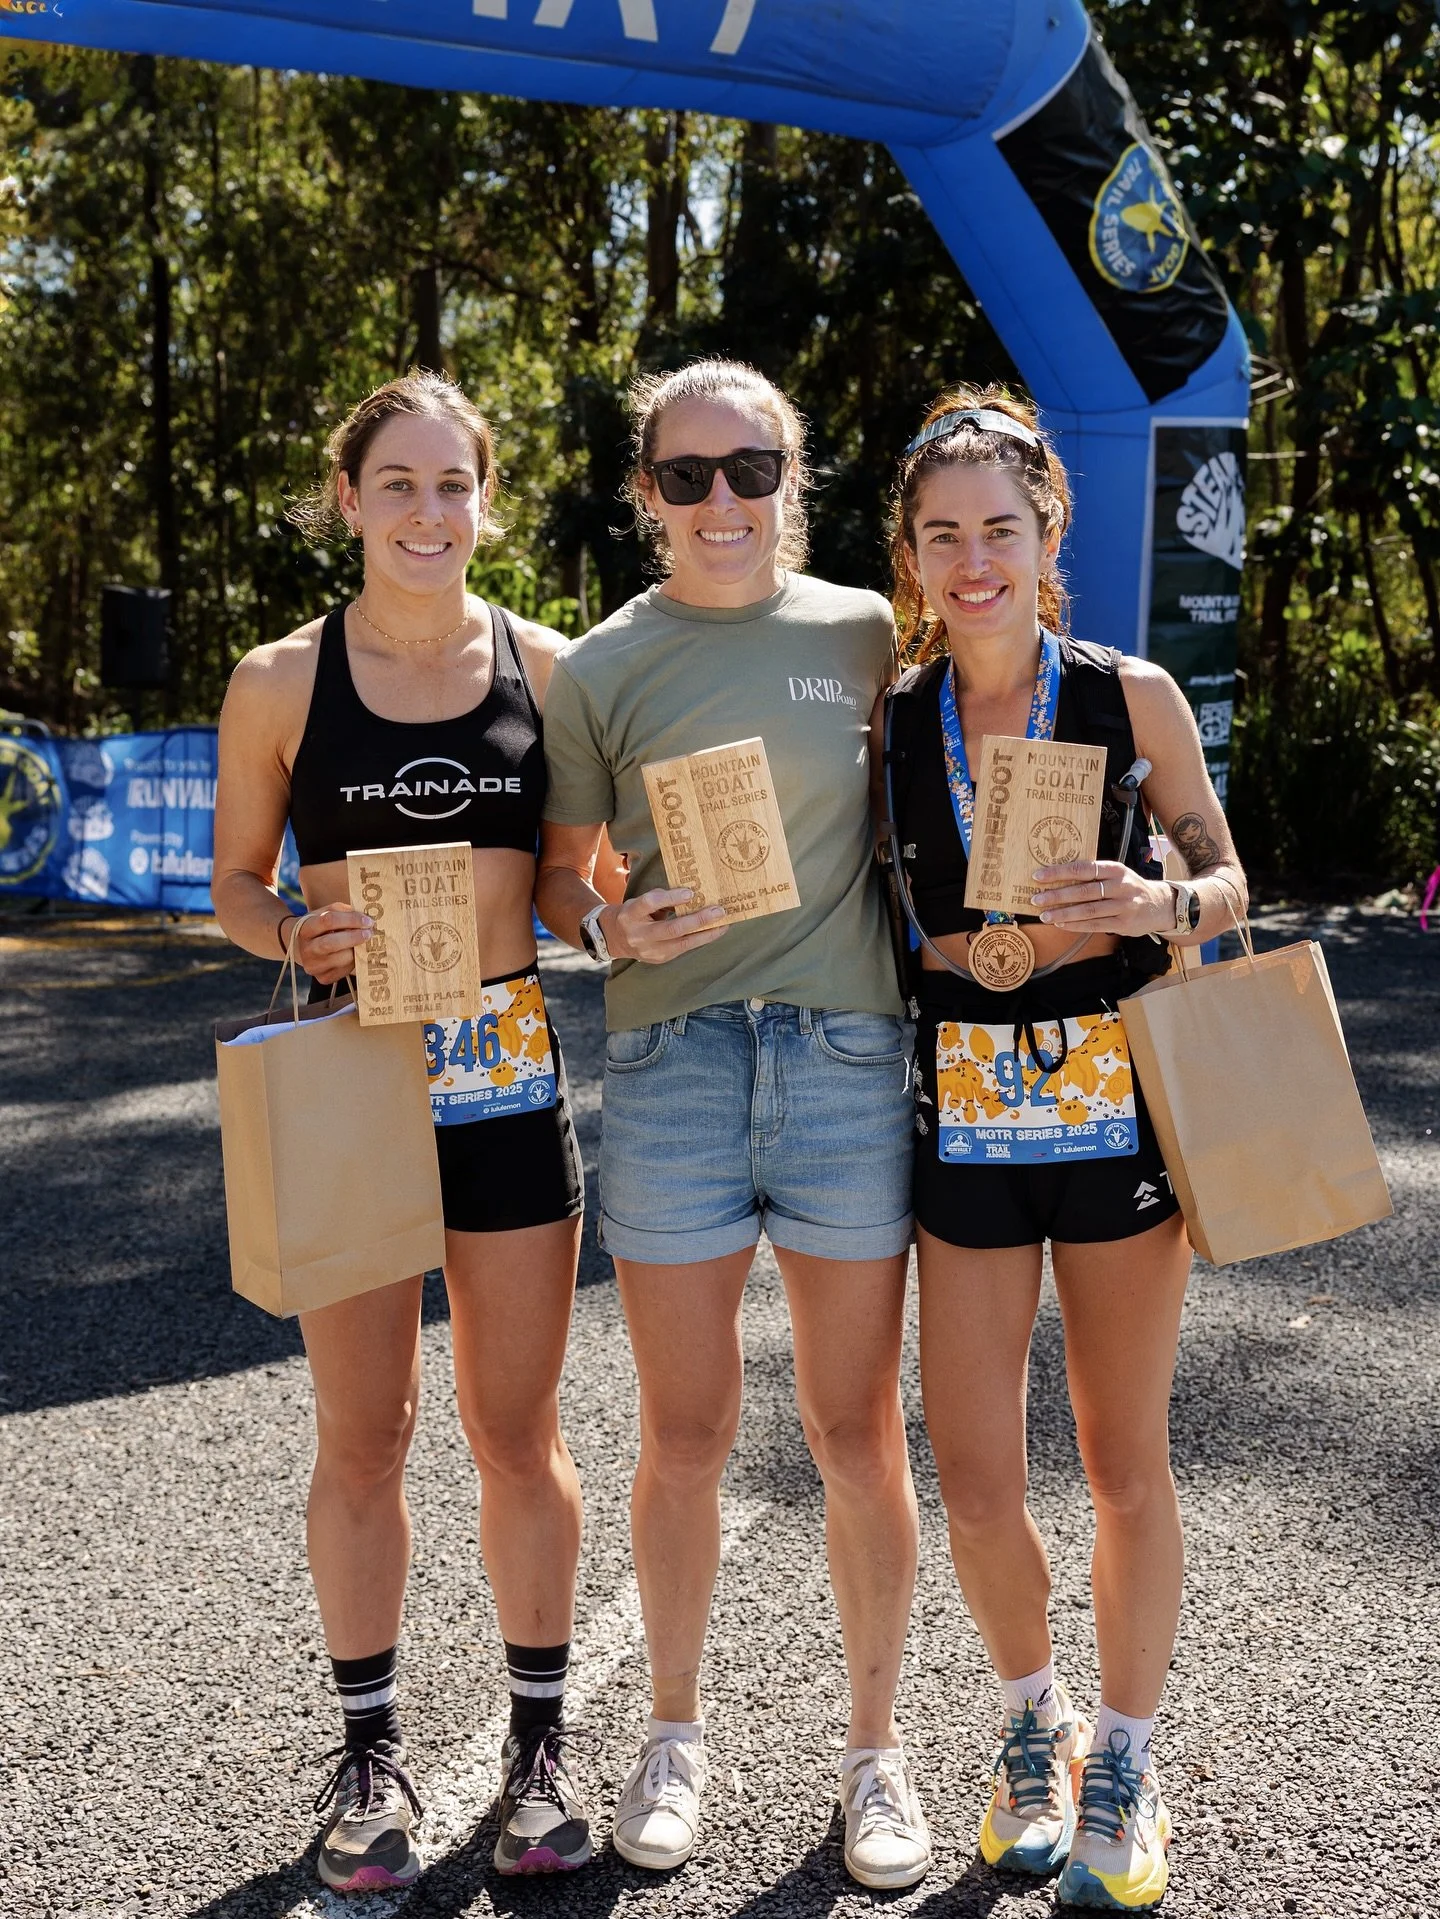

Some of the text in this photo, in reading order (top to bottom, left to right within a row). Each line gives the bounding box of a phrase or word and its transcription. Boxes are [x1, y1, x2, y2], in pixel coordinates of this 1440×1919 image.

[1102, 157, 1142, 277] TRAIL SERIES
[788, 676, 843, 703] DRIP
[690, 753, 762, 783] MOUNTAIN
[1027, 751, 1099, 772] MOUNTAIN
[340, 777, 522, 803] TRAINADE
[701, 770, 755, 800] GOAT
[1034, 768, 1090, 792] GOAT
[698, 789, 769, 814] TRAIL SERIES
[1024, 787, 1095, 806] TRAIL SERIES
[980, 748, 1014, 888] SUREFOOT
[1032, 819, 1064, 839] MOUNTAIN
[655, 776, 707, 911] SUREFOOT
[1033, 844, 1051, 864] TRAIL
[395, 858, 467, 877] MOUNTAIN
[403, 874, 459, 896] GOAT
[717, 881, 791, 906] SECOND PLACE
[975, 889, 1003, 901] 2025
[1012, 884, 1042, 896] THIRD
[397, 894, 469, 911] TRAIL SERIES
[722, 901, 760, 916] EMALE
[413, 924, 459, 947] MOUNTAIN GOAT
[416, 949, 459, 969] TRAIL SERIES
[984, 941, 1019, 958] MOUNTAIN GOAT
[986, 962, 1001, 976] TRAIL
[1001, 960, 1019, 976] SERIES
[402, 989, 466, 1004] FIRST PLACE
[368, 1002, 442, 1018] 2025 FEMALE
[424, 1013, 501, 1077] 346
[995, 1050, 1056, 1107] 92
[448, 1089, 493, 1105] SERIES
[495, 1082, 524, 1098] 2025
[490, 1102, 521, 1112] lululemon
[1016, 1126, 1063, 1141] SERIES
[1066, 1122, 1098, 1137] 2025
[986, 1146, 1010, 1154] TRAIL
[1062, 1144, 1097, 1153] lululemon
